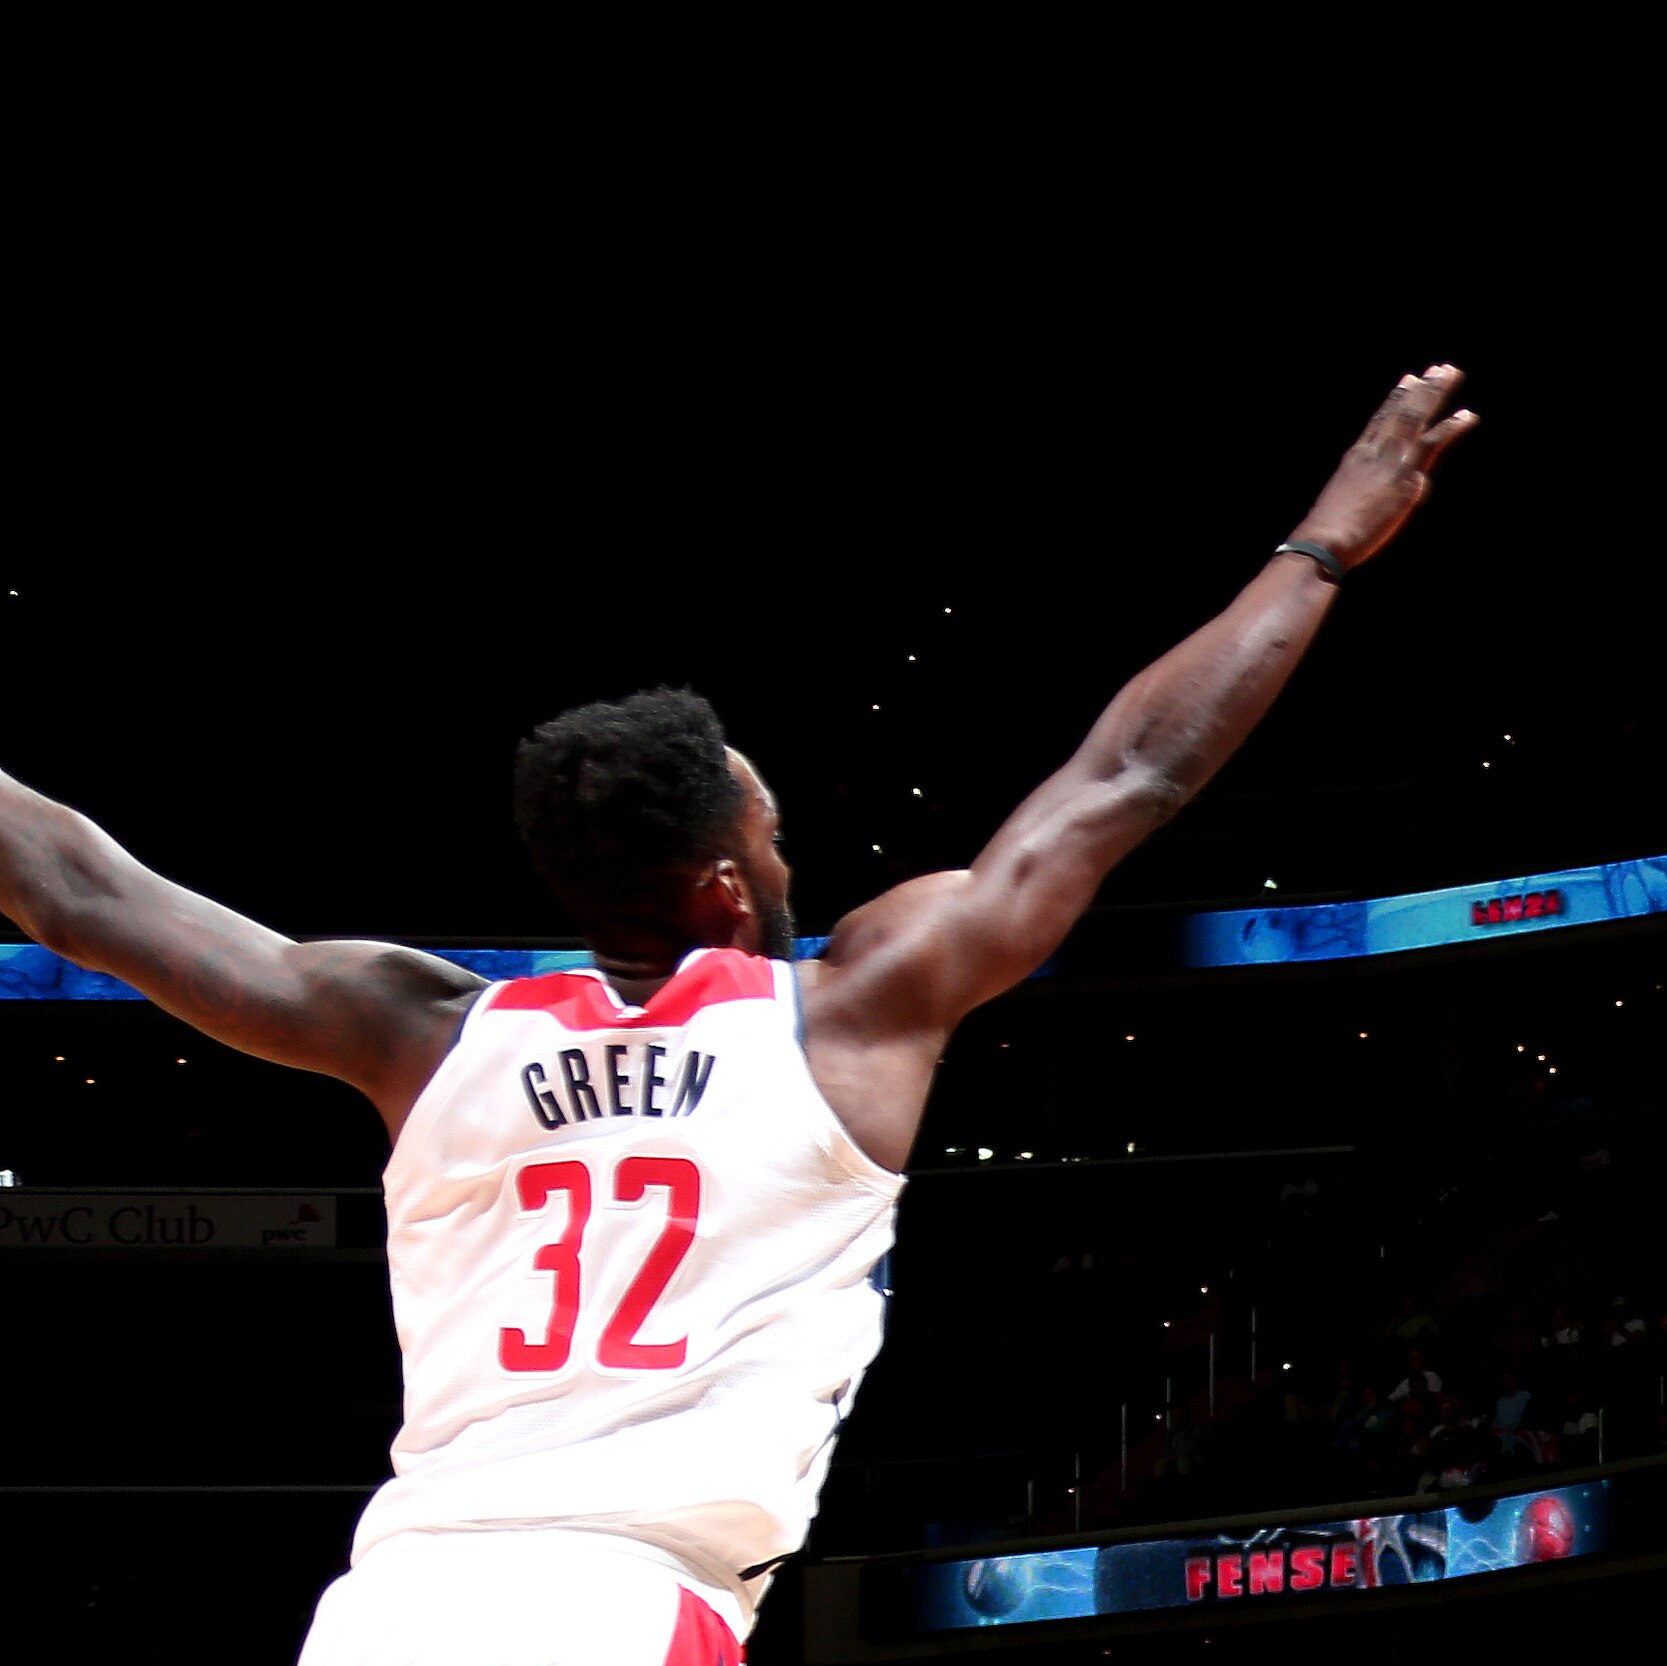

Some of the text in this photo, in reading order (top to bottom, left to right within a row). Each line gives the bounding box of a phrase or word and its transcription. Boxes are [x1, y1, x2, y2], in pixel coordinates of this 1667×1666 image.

[520, 1044, 716, 1131] GREEN
[108, 1204, 214, 1244] Club
[499, 1156, 700, 1372] 32
[1184, 1540, 1358, 1602] FENSE
